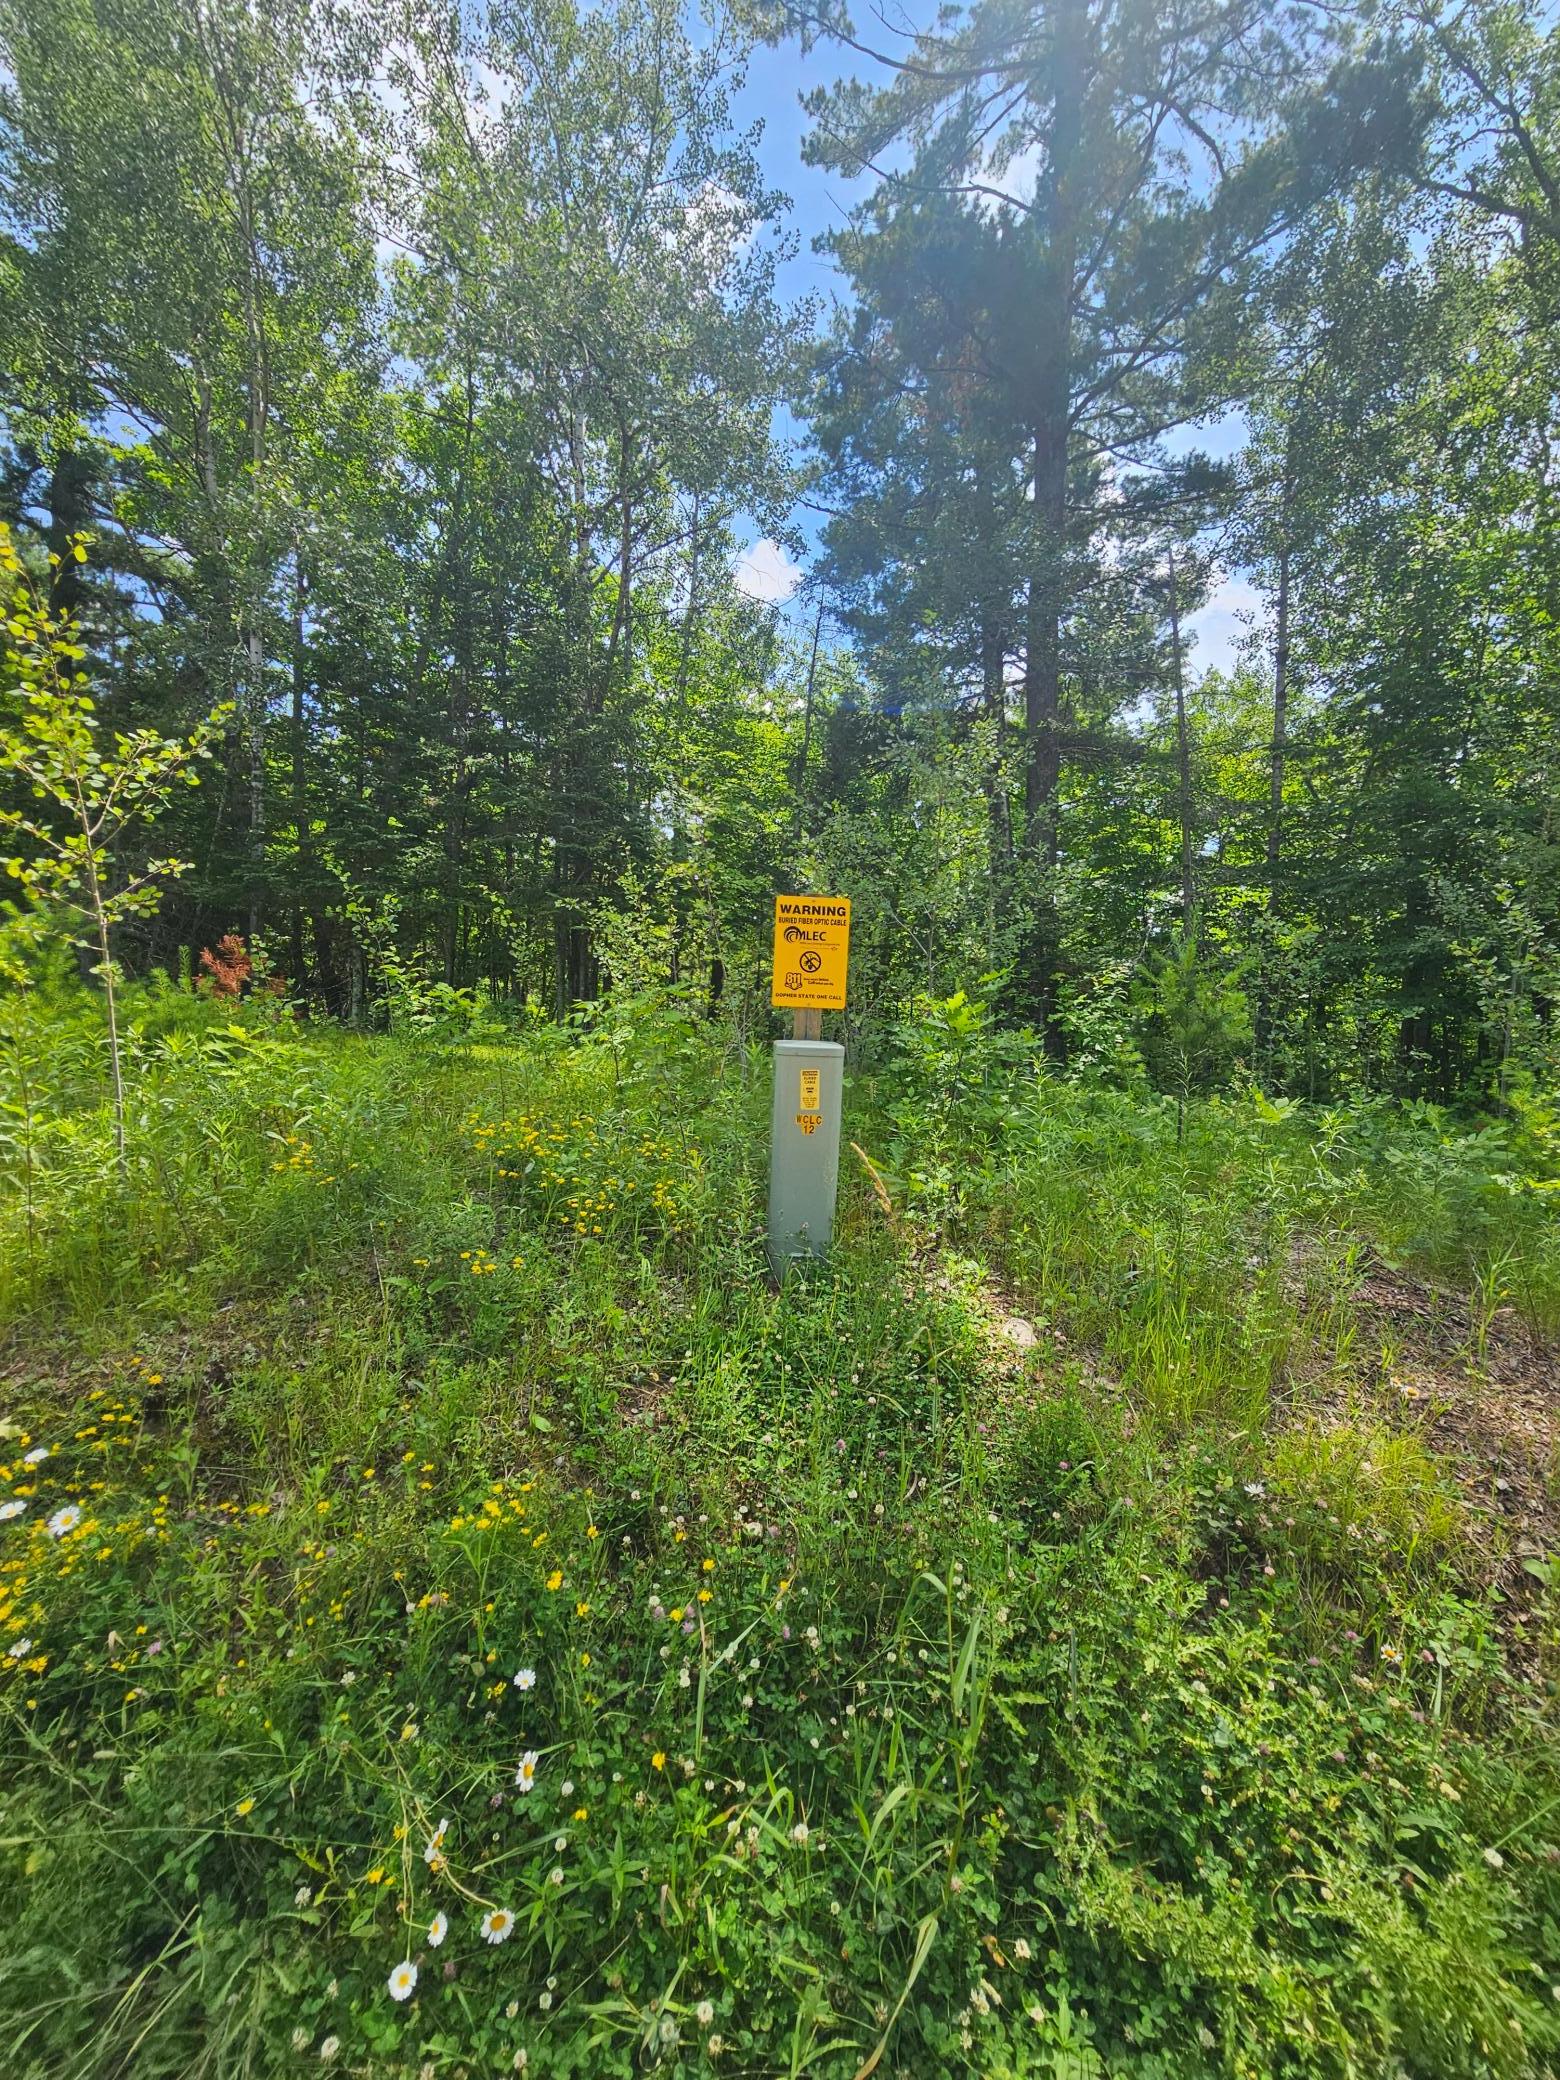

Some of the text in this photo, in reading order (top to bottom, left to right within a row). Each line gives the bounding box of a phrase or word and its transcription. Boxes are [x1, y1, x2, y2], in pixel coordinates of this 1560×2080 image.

[780, 904, 846, 917] WARNING
[799, 917, 813, 925] FIBER
[814, 918, 829, 926] OPTIC
[796, 931, 827, 941] MLEC
[786, 972, 802, 984] 811
[804, 1125, 814, 1134] 12
